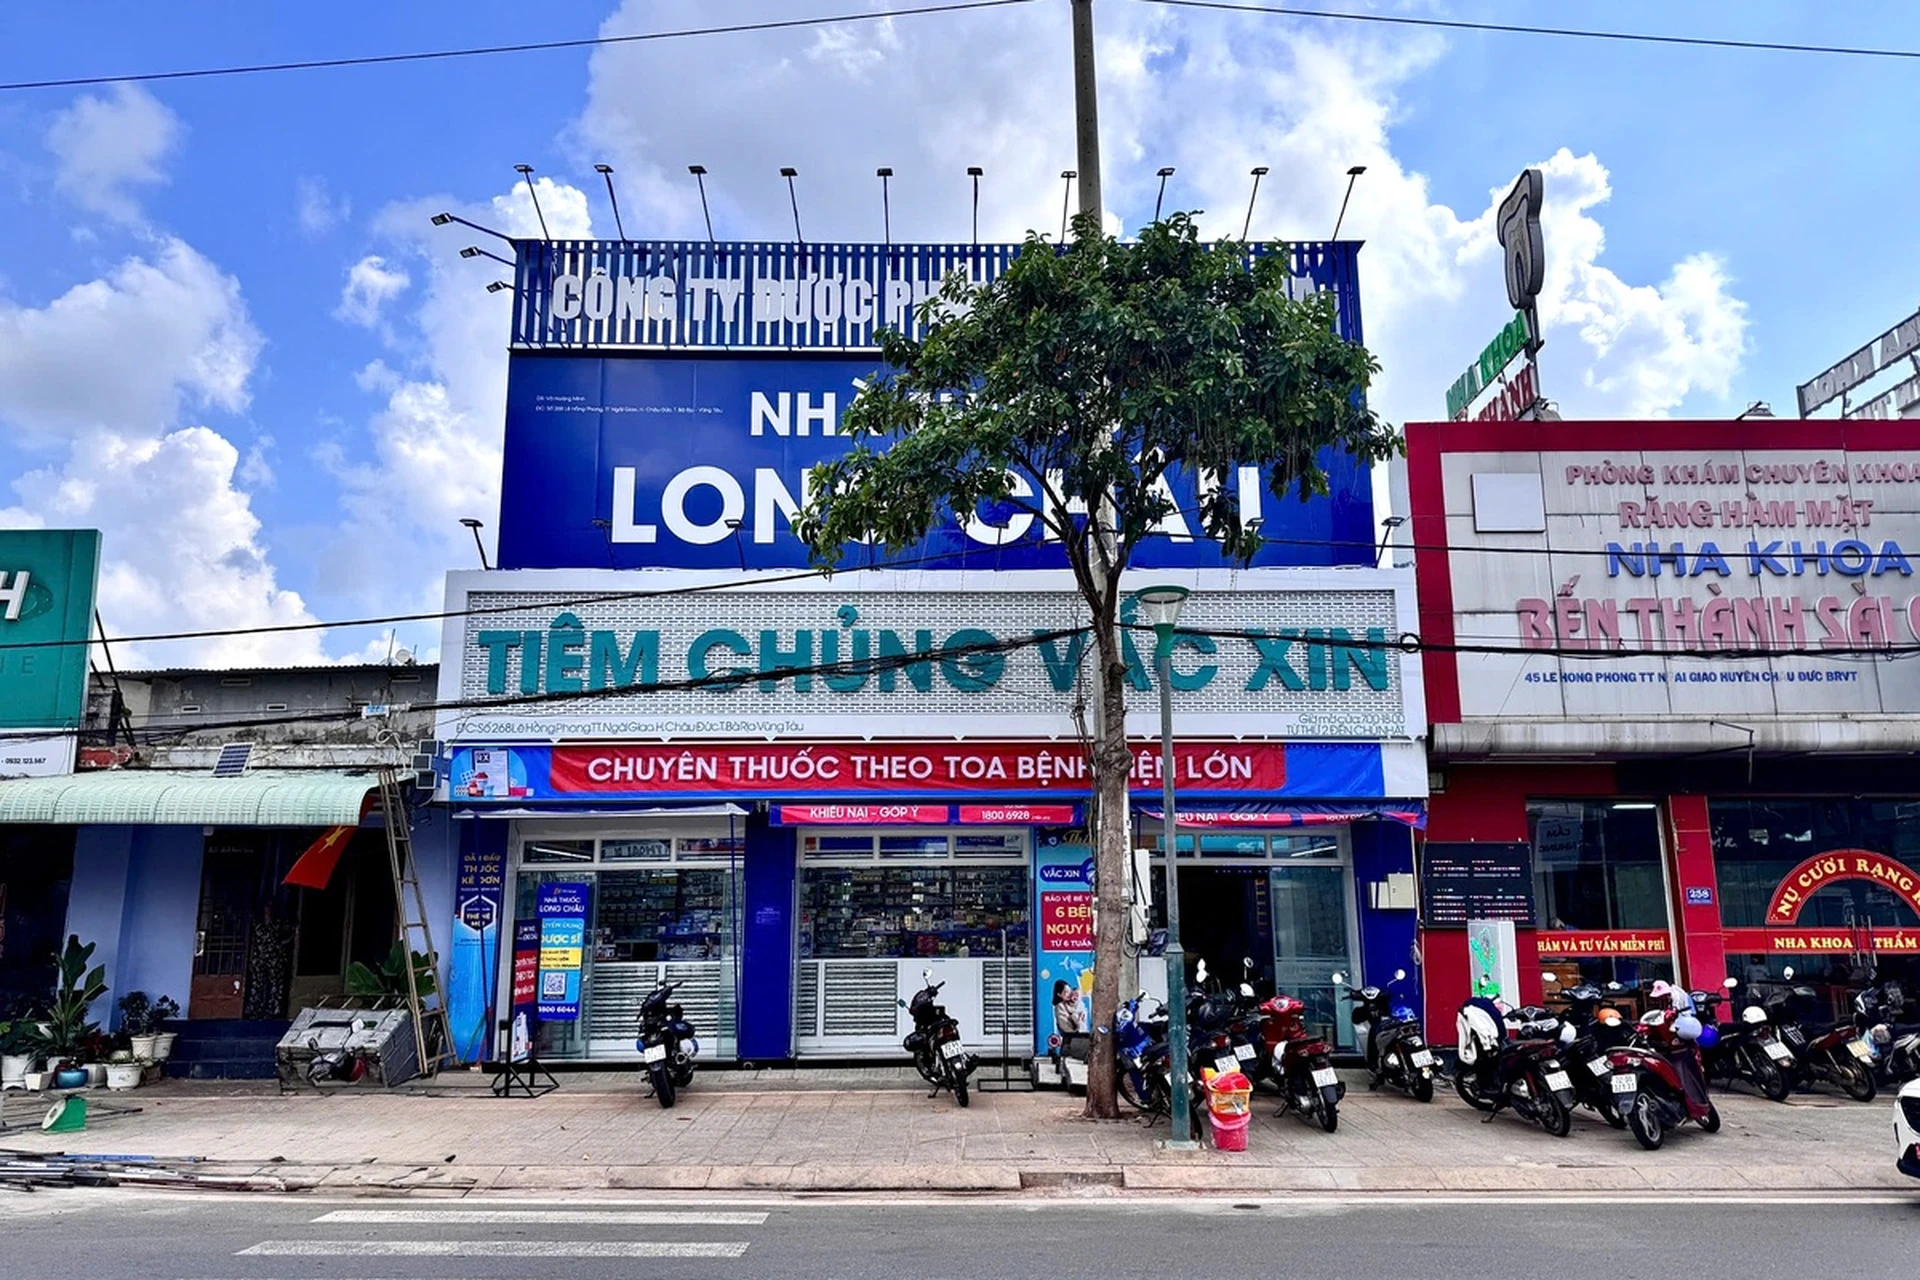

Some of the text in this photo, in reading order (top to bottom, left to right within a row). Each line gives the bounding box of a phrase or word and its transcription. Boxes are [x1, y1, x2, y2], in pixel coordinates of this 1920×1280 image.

[553, 267, 677, 321] CÔNG
[689, 278, 743, 322] TY
[1480, 309, 1531, 387] KHOA
[1566, 459, 1654, 485] PHÒNG
[1663, 460, 1740, 484] KHÁM
[1746, 459, 1848, 484] CHUYÊN
[611, 466, 893, 544] LON
[1619, 492, 1874, 533] RĂNG HÀM MẶT
[1606, 540, 1913, 577] NHA KHOA
[1517, 575, 1620, 650] BẾN
[1627, 583, 1806, 651] THÀNH
[1816, 581, 1897, 650] SÀI
[478, 611, 660, 697] TIÊM
[688, 604, 1005, 694] CHỦNG
[1244, 627, 1388, 692] XIN
[1524, 672, 1541, 683] 45
[1543, 672, 1557, 683] LE
[1595, 672, 1636, 683] PHONG
[1639, 672, 1656, 683] TT
[1689, 671, 1717, 683] GIAO
[1826, 671, 1857, 681] BRVT
[556, 722, 591, 735] Phong
[588, 751, 717, 782] CHUYÊN
[729, 746, 840, 782] THUỐC
[852, 755, 935, 779] THEO
[945, 755, 1006, 780] TOA
[1187, 749, 1252, 779] LỚN
[848, 806, 868, 822] NẠI
[981, 810, 1004, 820] 1800
[1006, 810, 1029, 820] 6928
[1064, 869, 1080, 878] XIN
[1777, 857, 1913, 917] NỤ CƯỜI RẠNG
[1055, 906, 1065, 918] 6
[1046, 924, 1084, 934] NGUY
[1537, 938, 1561, 951] HÁM
[1562, 939, 1577, 951] VÀ
[1579, 939, 1594, 951] TƯ
[1595, 936, 1619, 951] VẤN
[1620, 934, 1646, 951] MIỄN
[1774, 937, 1807, 949] NHA
[1810, 937, 1853, 949] KHOA
